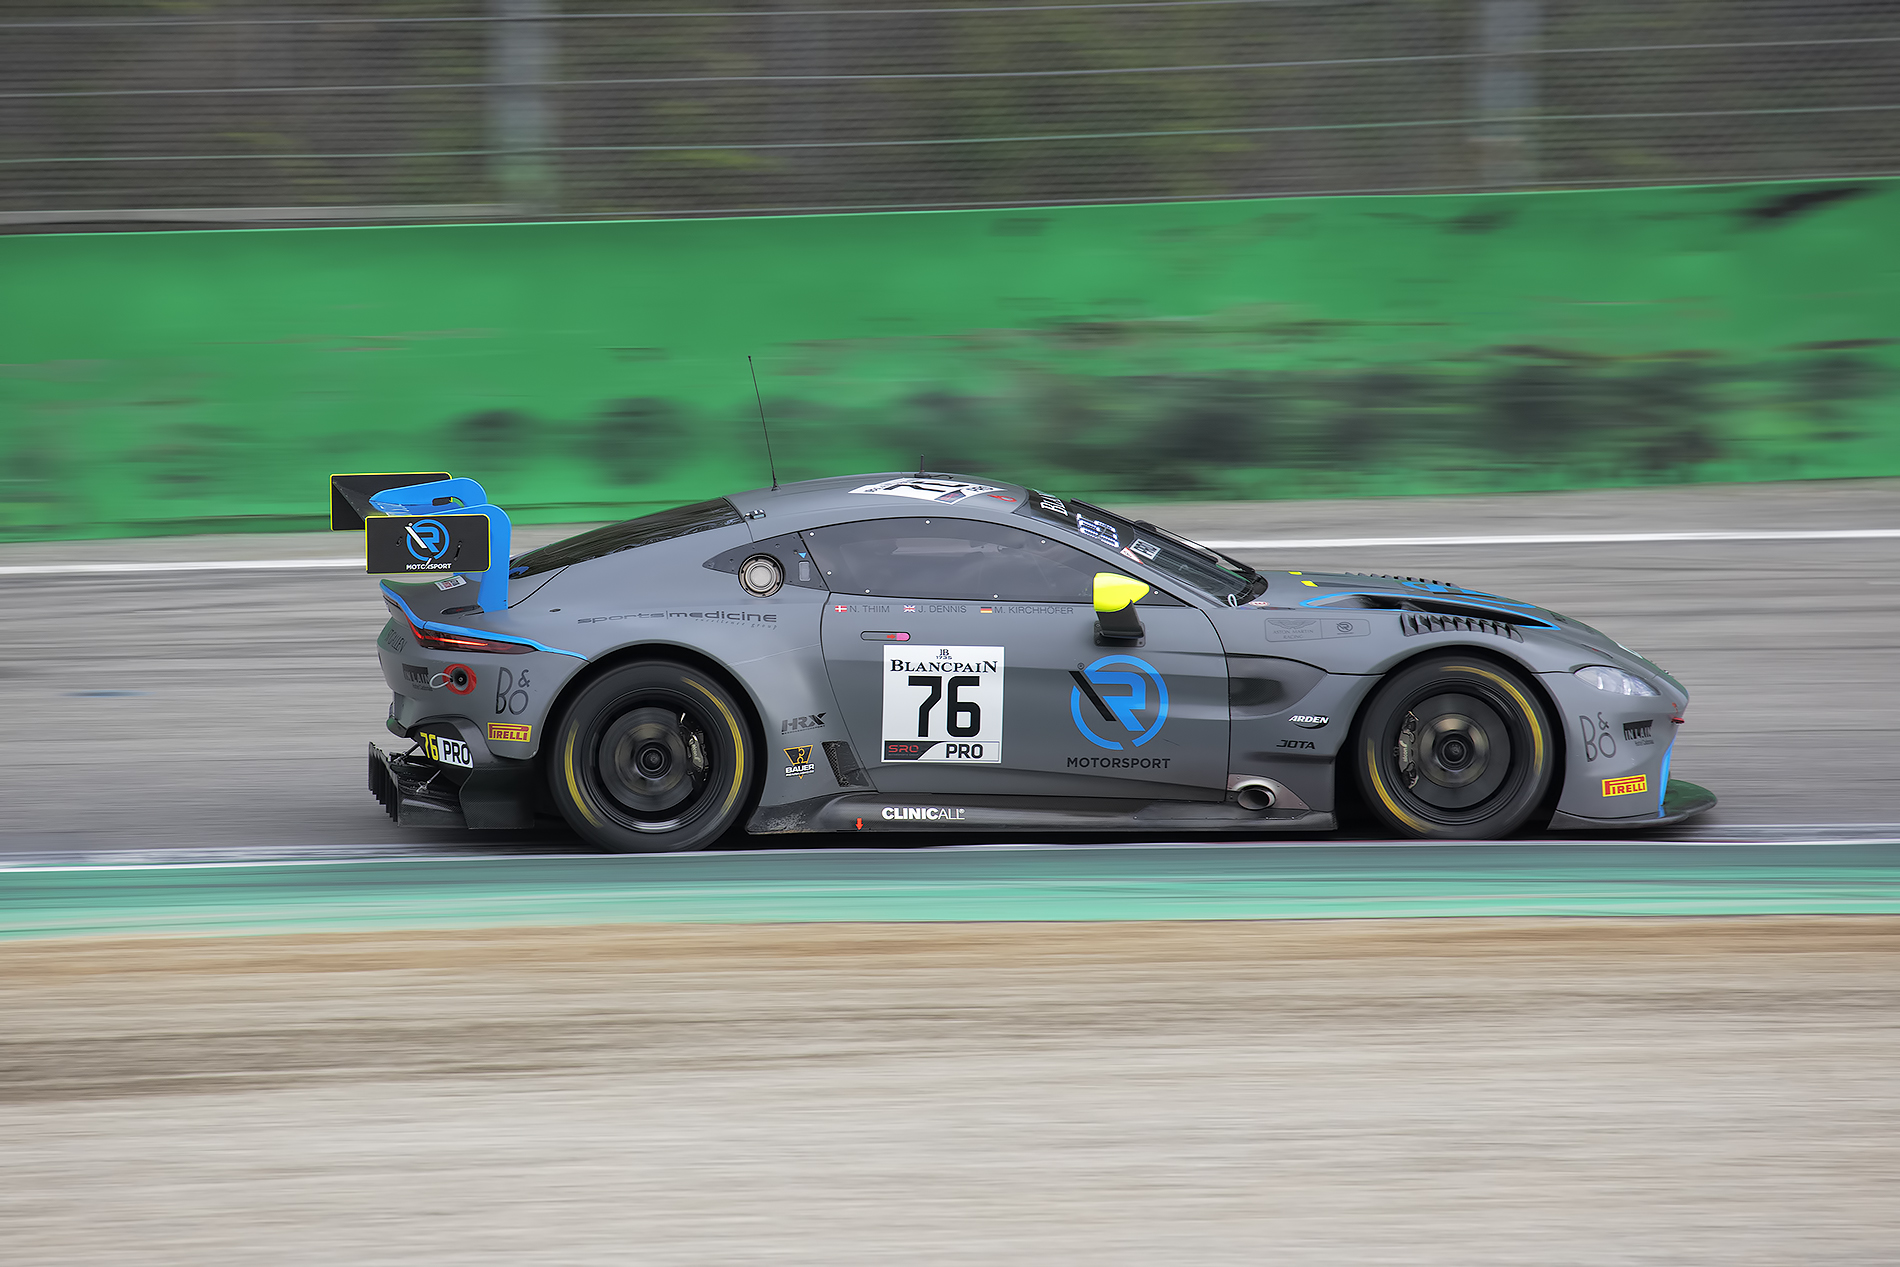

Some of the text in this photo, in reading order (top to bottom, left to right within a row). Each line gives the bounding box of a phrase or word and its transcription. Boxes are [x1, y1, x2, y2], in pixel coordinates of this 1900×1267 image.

[849, 605, 890, 613] N. THIIM
[929, 605, 967, 613] DENNIS
[890, 659, 998, 673] BLANCPAIN
[908, 675, 981, 738] 76
[1288, 715, 1329, 724] ARDEN
[489, 723, 530, 741] PIRELLI
[420, 731, 471, 765] 76 PRO
[888, 744, 919, 753] SRO
[1276, 739, 1316, 750] JOTA
[945, 743, 984, 759] PRO
[785, 763, 815, 774] BAUER
[1066, 757, 1171, 769] MOTORSPORT
[1604, 775, 1647, 796] PIRELLI
